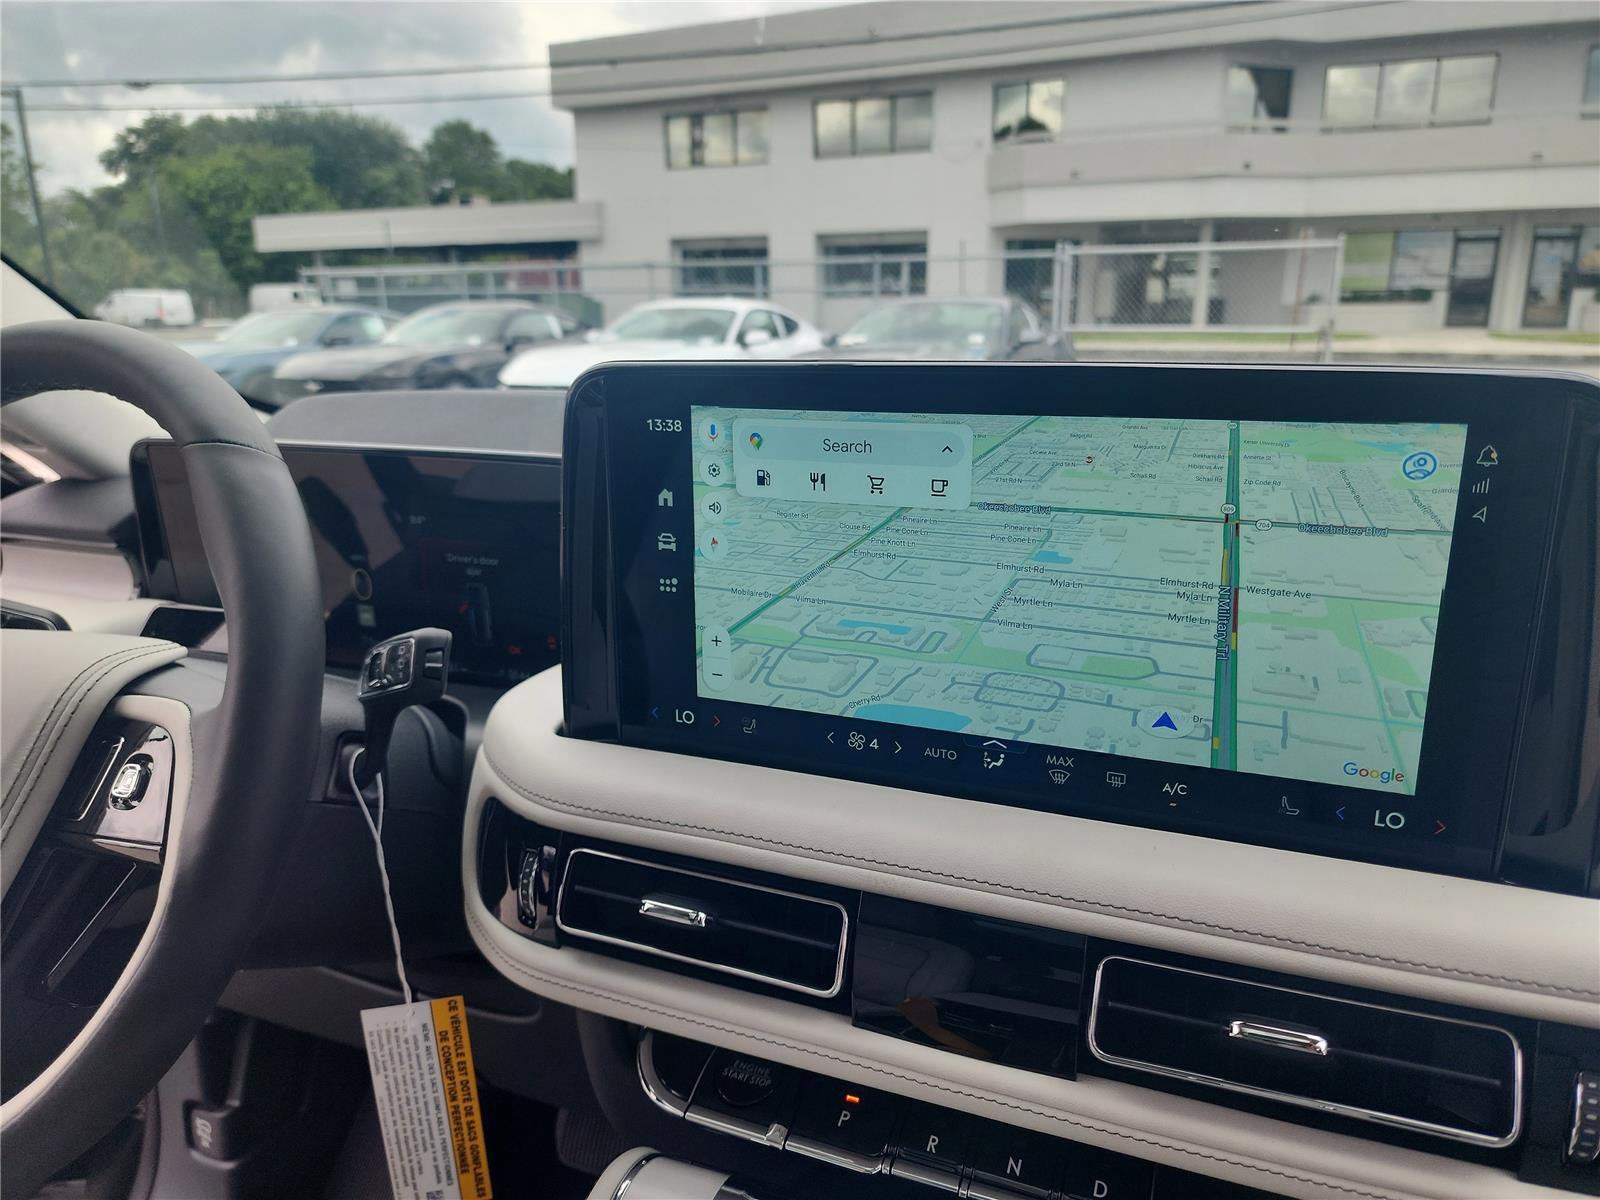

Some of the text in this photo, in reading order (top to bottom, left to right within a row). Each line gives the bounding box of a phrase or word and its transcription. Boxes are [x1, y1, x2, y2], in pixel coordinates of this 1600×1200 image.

[646, 419, 682, 432] 13:38
[822, 438, 872, 454] Search
[977, 501, 1052, 514] Okeechobee Blvd
[1298, 523, 1389, 537] Okeechobee Blvd
[448, 553, 479, 564] Driver's
[853, 550, 884, 558] Elmhurst
[996, 562, 1031, 573] Elmhurst
[1050, 579, 1070, 588] Myla
[1160, 577, 1199, 588] Elmhurst
[795, 595, 816, 603] Vilma
[1176, 591, 1199, 601] Myla
[1246, 586, 1312, 599] Westgate Ave
[991, 595, 1006, 613] West
[1013, 597, 1041, 606] Myrtle
[997, 619, 1021, 628] Vilma
[1168, 613, 1211, 624] Myrtle Ln
[1214, 585, 1231, 661] N Military Trl
[675, 708, 695, 724] LO
[1193, 715, 1204, 723] Dr
[869, 739, 879, 750] 4
[924, 747, 957, 760] AUTO
[1046, 755, 1074, 767] MAX
[1343, 762, 1405, 784] Google
[1162, 782, 1188, 795] A/C
[1374, 810, 1405, 829] LO
[448, 1000, 458, 1012] CE
[439, 1030, 449, 1043] DE
[457, 1059, 468, 1075] EST
[441, 1046, 458, 1102] CONCEPTION
[464, 1104, 474, 1118] DE
[838, 1111, 851, 1127] P
[466, 1119, 478, 1141] SACS
[927, 1135, 939, 1153] R
[1006, 1156, 1023, 1176] N
[1093, 1180, 1108, 1198] D
